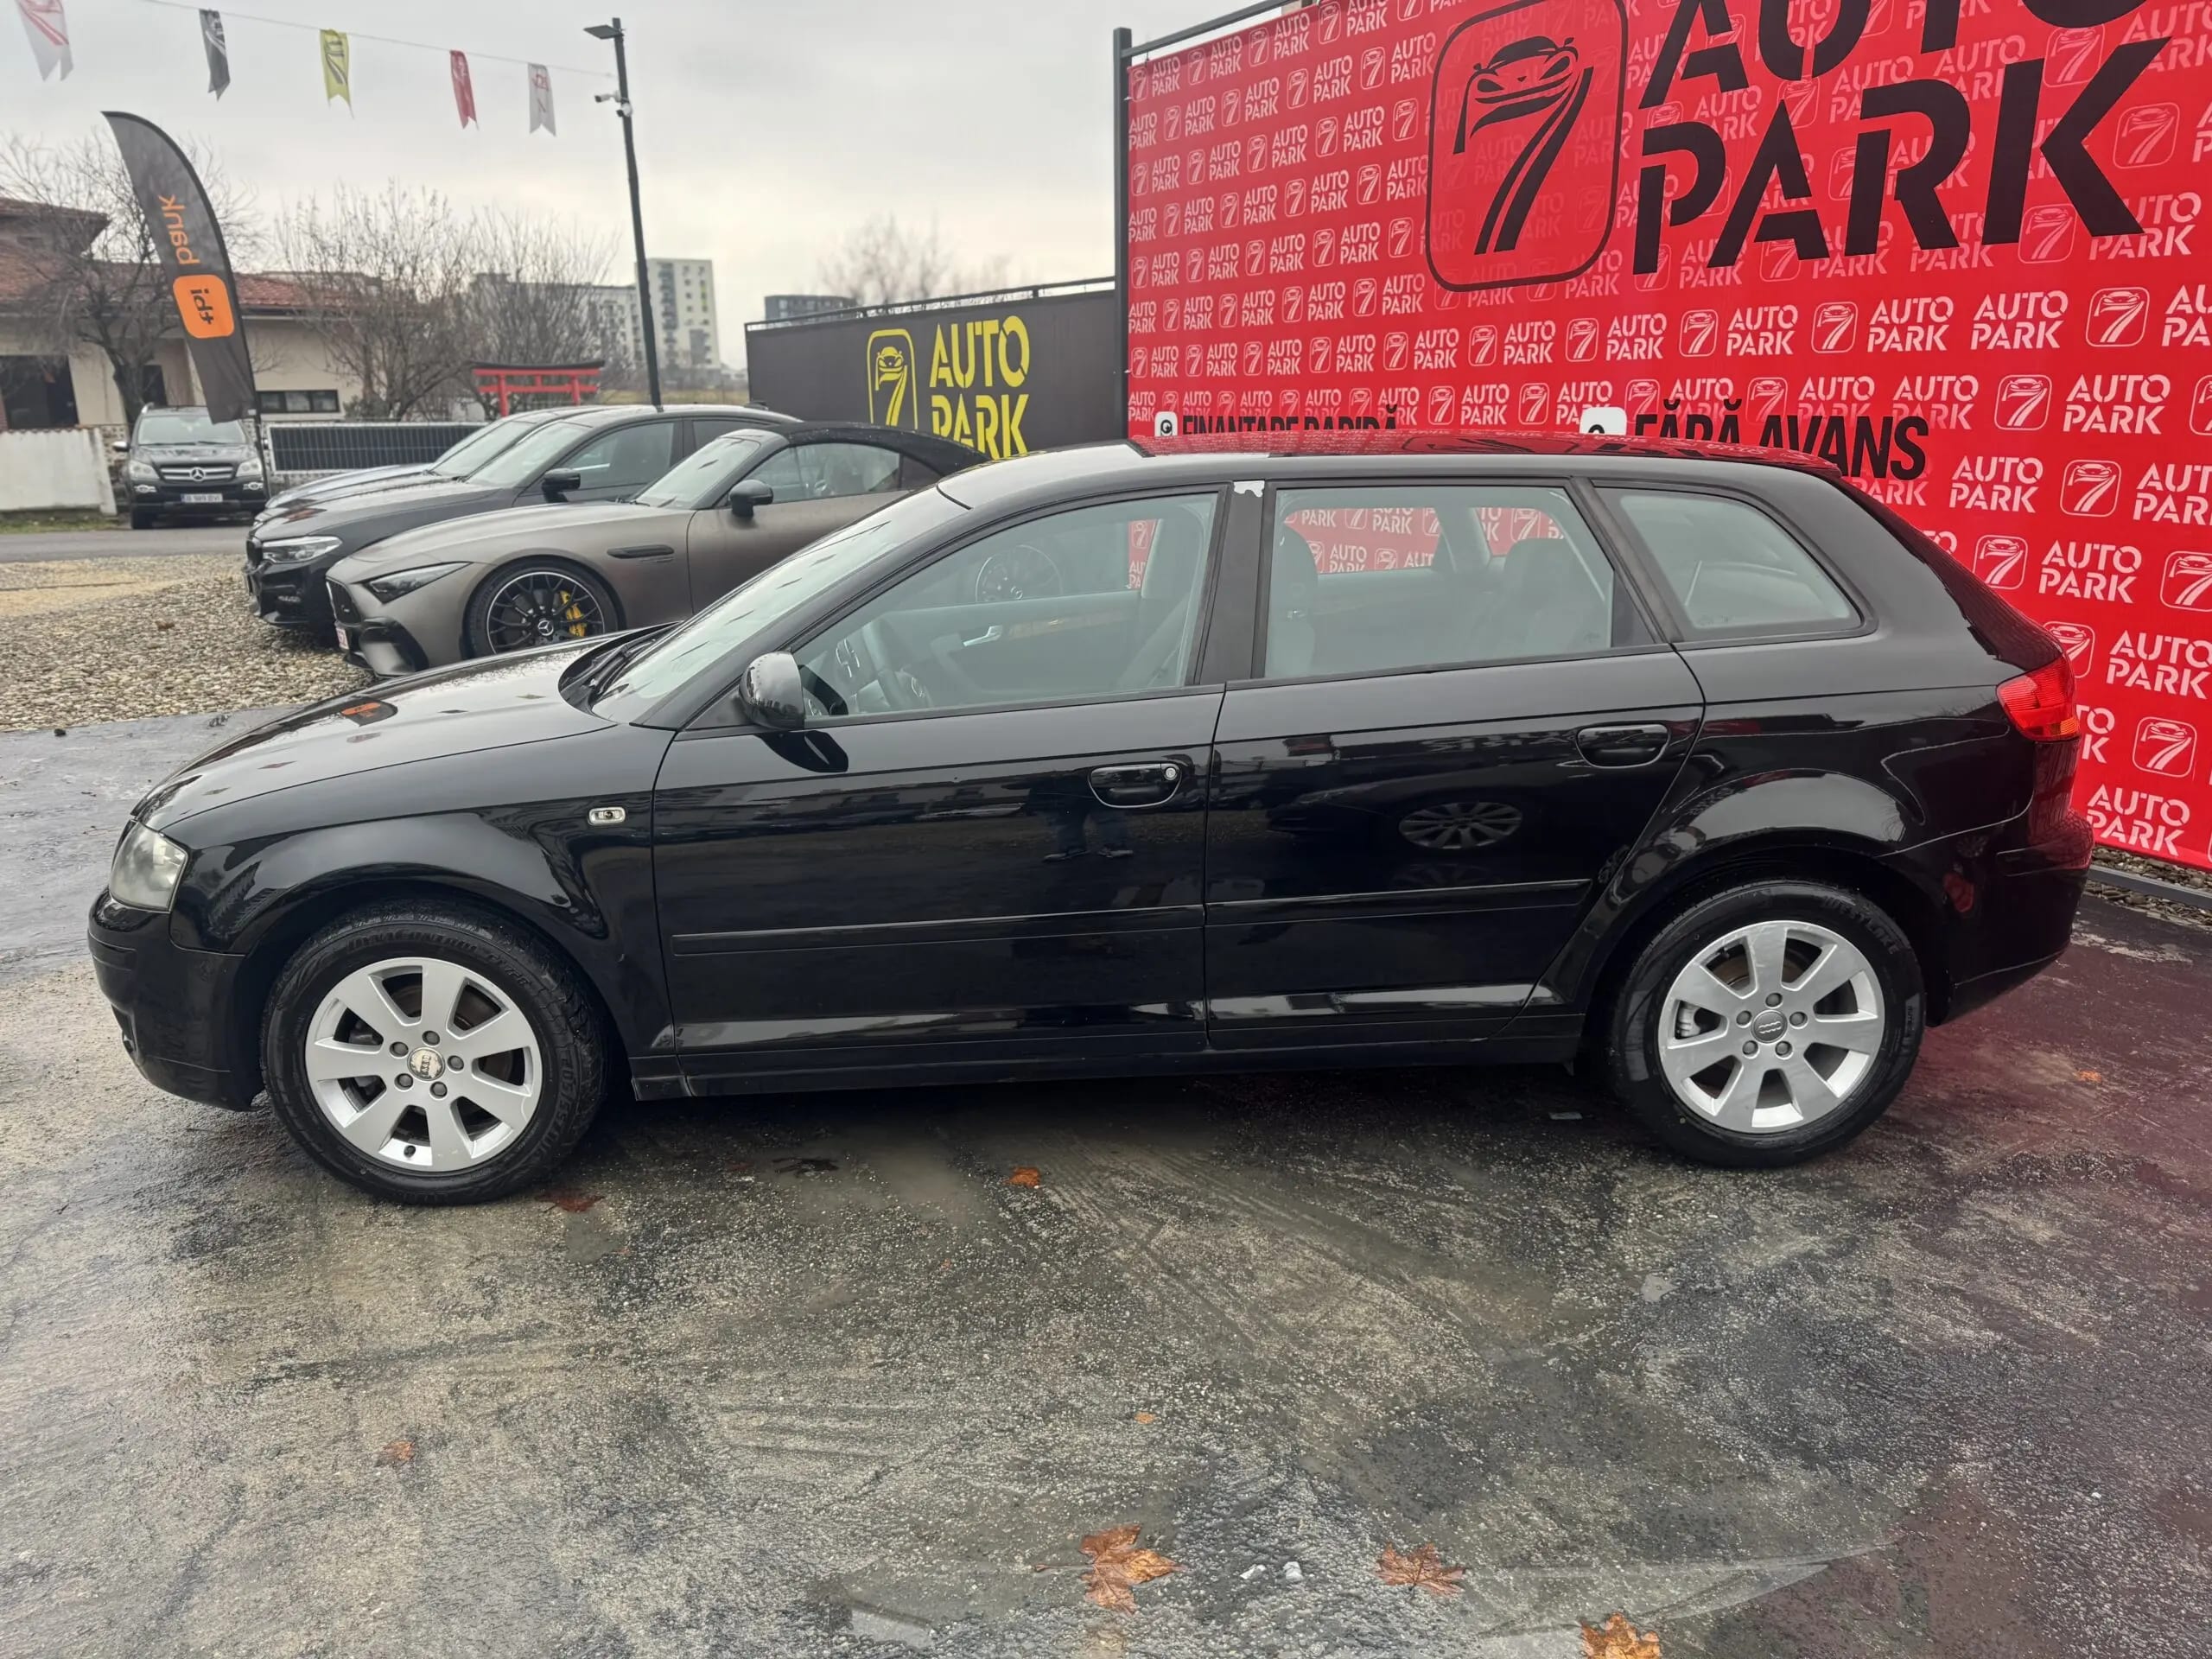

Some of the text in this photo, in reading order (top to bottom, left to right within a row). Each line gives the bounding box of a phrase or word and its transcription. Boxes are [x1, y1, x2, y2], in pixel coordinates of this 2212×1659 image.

[1274, 12, 1311, 38] AUTO
[1347, 8, 1387, 36] PARK
[1906, 0, 1991, 29] PK
[1211, 35, 1243, 60] AUTO
[1274, 32, 1309, 60] PARK
[1390, 33, 1437, 63] AUTO
[1637, 0, 2150, 109] AU
[1934, 35, 2025, 76] AUTO
[2149, 35, 2212, 72] RK
[1153, 57, 1180, 79] AUTO
[1211, 58, 1243, 79] PARK
[1314, 55, 1352, 83] AUTO
[1391, 54, 1433, 83] PARK
[1832, 56, 1914, 95] AUTO
[1152, 77, 1180, 98] PARK
[1245, 78, 1279, 103] AUTO
[1314, 75, 1351, 103] PARK
[1185, 96, 1215, 118] AUTO
[1245, 96, 1278, 121] PARK
[1694, 86, 1763, 120] AUTO
[1829, 94, 1860, 124] PA
[1129, 112, 1157, 133] AUTO
[1185, 113, 1214, 137] PARK
[1344, 106, 1384, 132] AUTO
[1712, 111, 1758, 142] RK
[1129, 132, 1157, 151] PARK
[1273, 124, 1307, 149] AUTO
[1344, 126, 1382, 152] PARK
[1210, 141, 1241, 162] AUTO
[1272, 143, 1306, 168] PARK
[1632, 36, 2172, 275] PARK
[1152, 156, 1179, 175] AUTO
[1210, 159, 1239, 181] PARK
[1387, 157, 1427, 180] AUTO
[1153, 172, 1179, 193] PARK
[1312, 170, 1349, 194] AUTO
[1387, 175, 1427, 200] PARK
[1185, 197, 1214, 217] AUTO
[1244, 185, 1277, 207] AUTO
[1312, 189, 1347, 213] PARK
[1128, 207, 1157, 226] AUTO
[1185, 214, 1213, 234] PARK
[1244, 203, 1275, 225] PARK
[1128, 224, 1156, 243] PARK
[1270, 234, 1305, 254] AUTO
[1341, 222, 1380, 245] AUTO
[2089, 225, 2196, 260] PARK
[1152, 252, 1179, 270] AUTO
[1209, 244, 1239, 263] AUTO
[1270, 252, 1303, 273] PARK
[1340, 242, 1378, 264] PARK
[1812, 249, 1890, 279] PARK
[1910, 241, 1994, 272] PARK
[1152, 269, 1179, 286] PARK
[1209, 261, 1238, 280] PARK
[1680, 261, 1742, 289] PARK
[1309, 282, 1345, 302] AUTO
[1382, 274, 1424, 295] AUTO
[1566, 273, 1619, 298] PARK
[1128, 302, 1156, 317] AUTO
[1184, 296, 1213, 313] AUTO
[1243, 289, 1274, 308] AUTO
[1382, 294, 1422, 315] PARK
[1870, 296, 1953, 324] AUTO
[1974, 291, 2068, 321] AUTO
[1184, 313, 1211, 330] PARK
[1243, 308, 1273, 326] PARK
[1308, 301, 1344, 321] PARK
[1728, 305, 1797, 331] AUTO
[1128, 317, 1155, 334] PARK
[1504, 321, 1555, 343] AUTO
[1607, 314, 1667, 337] AUTO
[1971, 321, 2063, 349] PARK
[1268, 339, 1302, 357] AUTO
[1337, 334, 1376, 353] AUTO
[1414, 328, 1459, 349] AUTO
[1606, 337, 1663, 360] PARK
[1727, 331, 1794, 356] PARK
[1868, 325, 1949, 352] PARK
[929, 315, 1030, 389] AUTO
[1152, 346, 1179, 361] AUTO
[1207, 343, 1237, 359] AUTO
[1337, 353, 1374, 372] PARK
[1414, 349, 1457, 369] PARK
[1504, 342, 1553, 365] PARK
[1152, 362, 1178, 377] PARK
[1207, 360, 1236, 376] PARK
[1268, 358, 1300, 375] PARK
[1128, 391, 1155, 406] AUTO
[1183, 391, 1211, 406] AUTO
[1241, 391, 1272, 406] AUTO
[1306, 389, 1341, 405] AUTO
[1378, 387, 1419, 405] AUTO
[1462, 384, 1510, 404] AUTO
[1557, 381, 1612, 402] AUTO
[1669, 378, 1733, 401] AUTO
[1799, 377, 1874, 400] AUTO
[1893, 375, 1978, 401] AUTO
[2067, 375, 2170, 403] AUTO
[1128, 407, 1154, 421] PARK
[1378, 407, 1417, 425] PRK
[1461, 405, 1507, 424] PARK
[2063, 405, 2164, 434] PARK
[931, 393, 1029, 461] PARK
[1758, 415, 1929, 480] AVANS
[1953, 456, 2043, 484] AUTO
[1949, 483, 2037, 512] PARK
[2133, 493, 2212, 525] PAR
[1301, 510, 1336, 527] PARK
[1373, 515, 1412, 534] PARK
[1330, 544, 1367, 563] AUTO
[1404, 552, 1433, 568] AUT
[2042, 541, 2141, 573] AUTO
[2039, 568, 2136, 603] PARK
[2109, 630, 2212, 668] AUTO
[2107, 658, 2209, 699] PARK
[2087, 785, 2190, 828] AUTO
[2087, 810, 2185, 856] PARK
